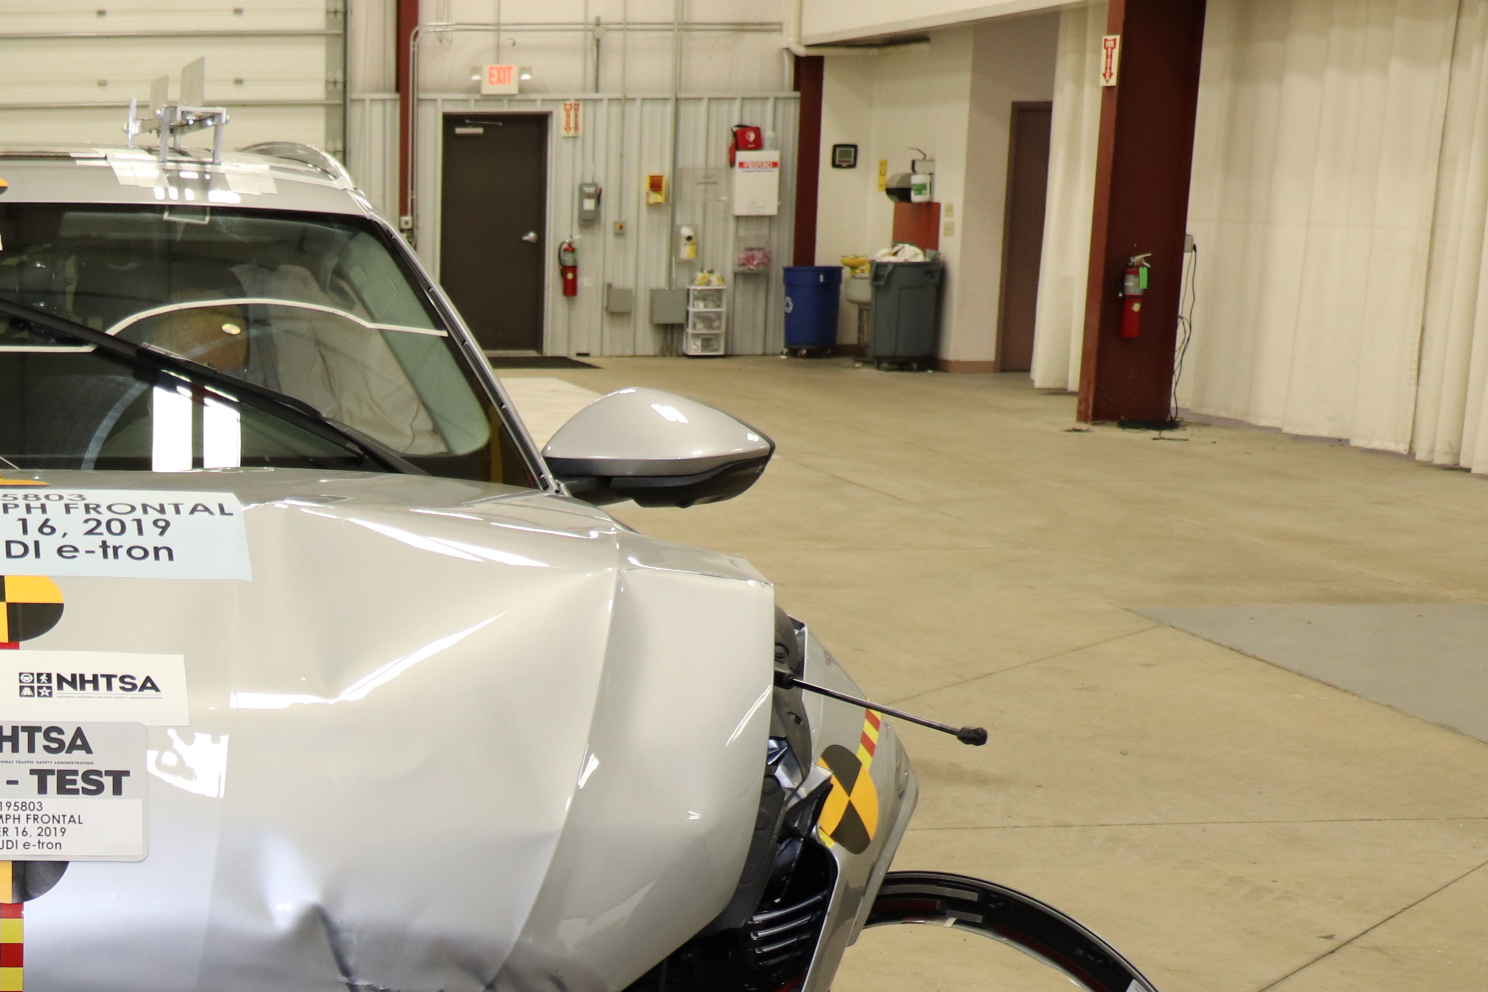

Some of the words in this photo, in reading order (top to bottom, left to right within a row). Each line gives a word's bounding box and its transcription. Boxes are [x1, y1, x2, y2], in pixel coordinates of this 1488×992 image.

[487, 65, 514, 85] EXIT
[64, 503, 234, 516] FRONTAL
[16, 518, 68, 538] 16,
[82, 518, 171, 537] 2019
[56, 540, 174, 561] e-tron
[56, 673, 161, 693] NHTSA
[29, 768, 131, 796] TEST
[25, 814, 83, 825] FRONTAL
[14, 827, 32, 838] 16,
[36, 827, 67, 837] 2019
[22, 839, 62, 850] e-tron
